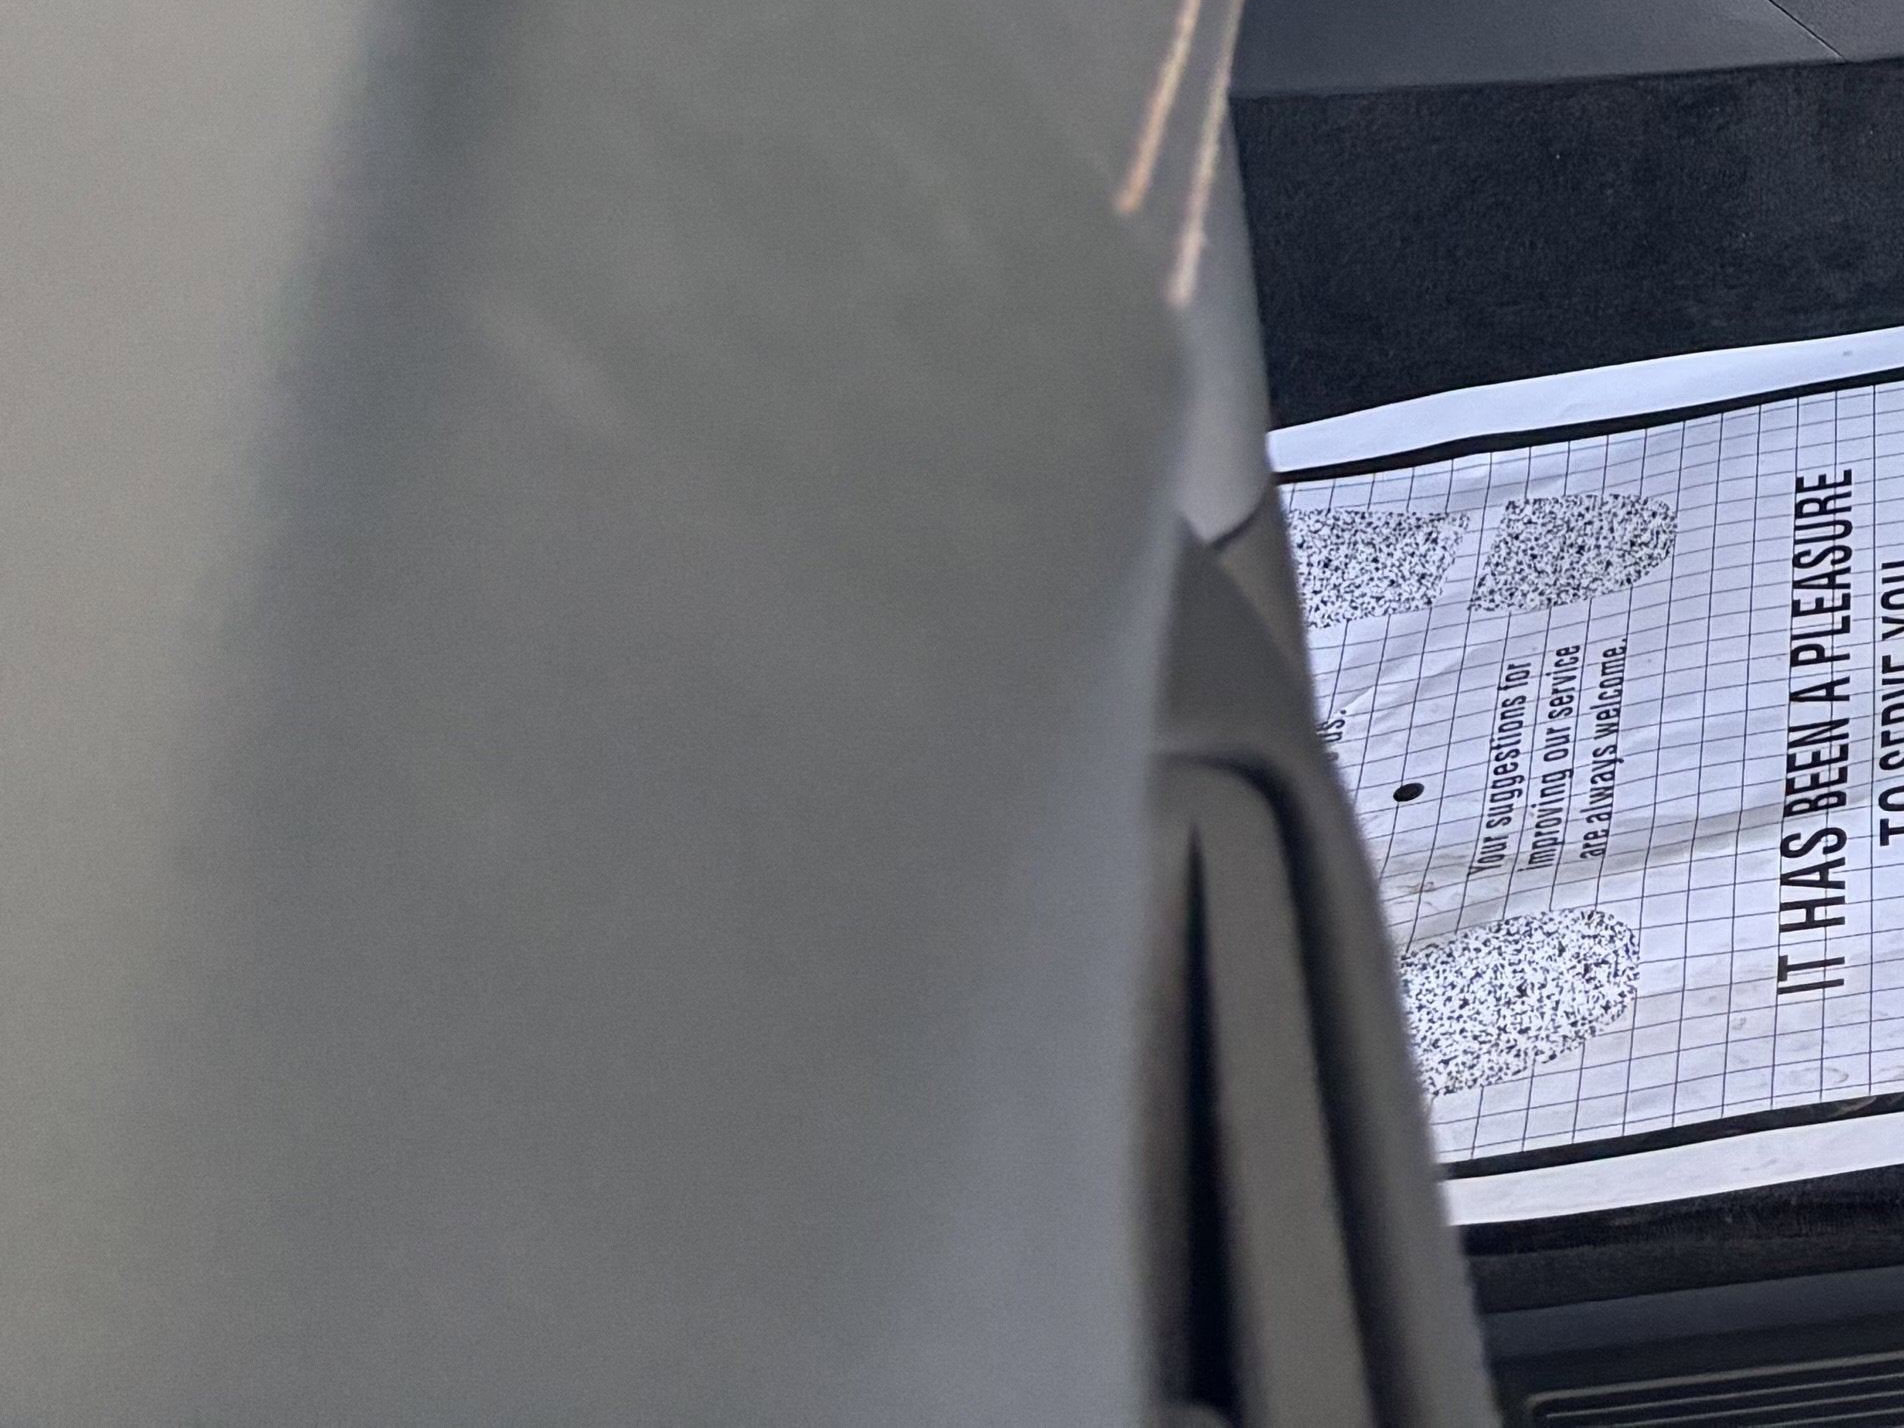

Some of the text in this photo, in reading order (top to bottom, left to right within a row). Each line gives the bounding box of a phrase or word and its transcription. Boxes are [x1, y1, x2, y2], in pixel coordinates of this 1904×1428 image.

[1467, 661, 1532, 878] Your suggestions for
[1516, 644, 1581, 873] improving our service
[1579, 638, 1628, 859] are always welcome.
[1777, 468, 1853, 994] IT HAS BEEN A PLEASURE
